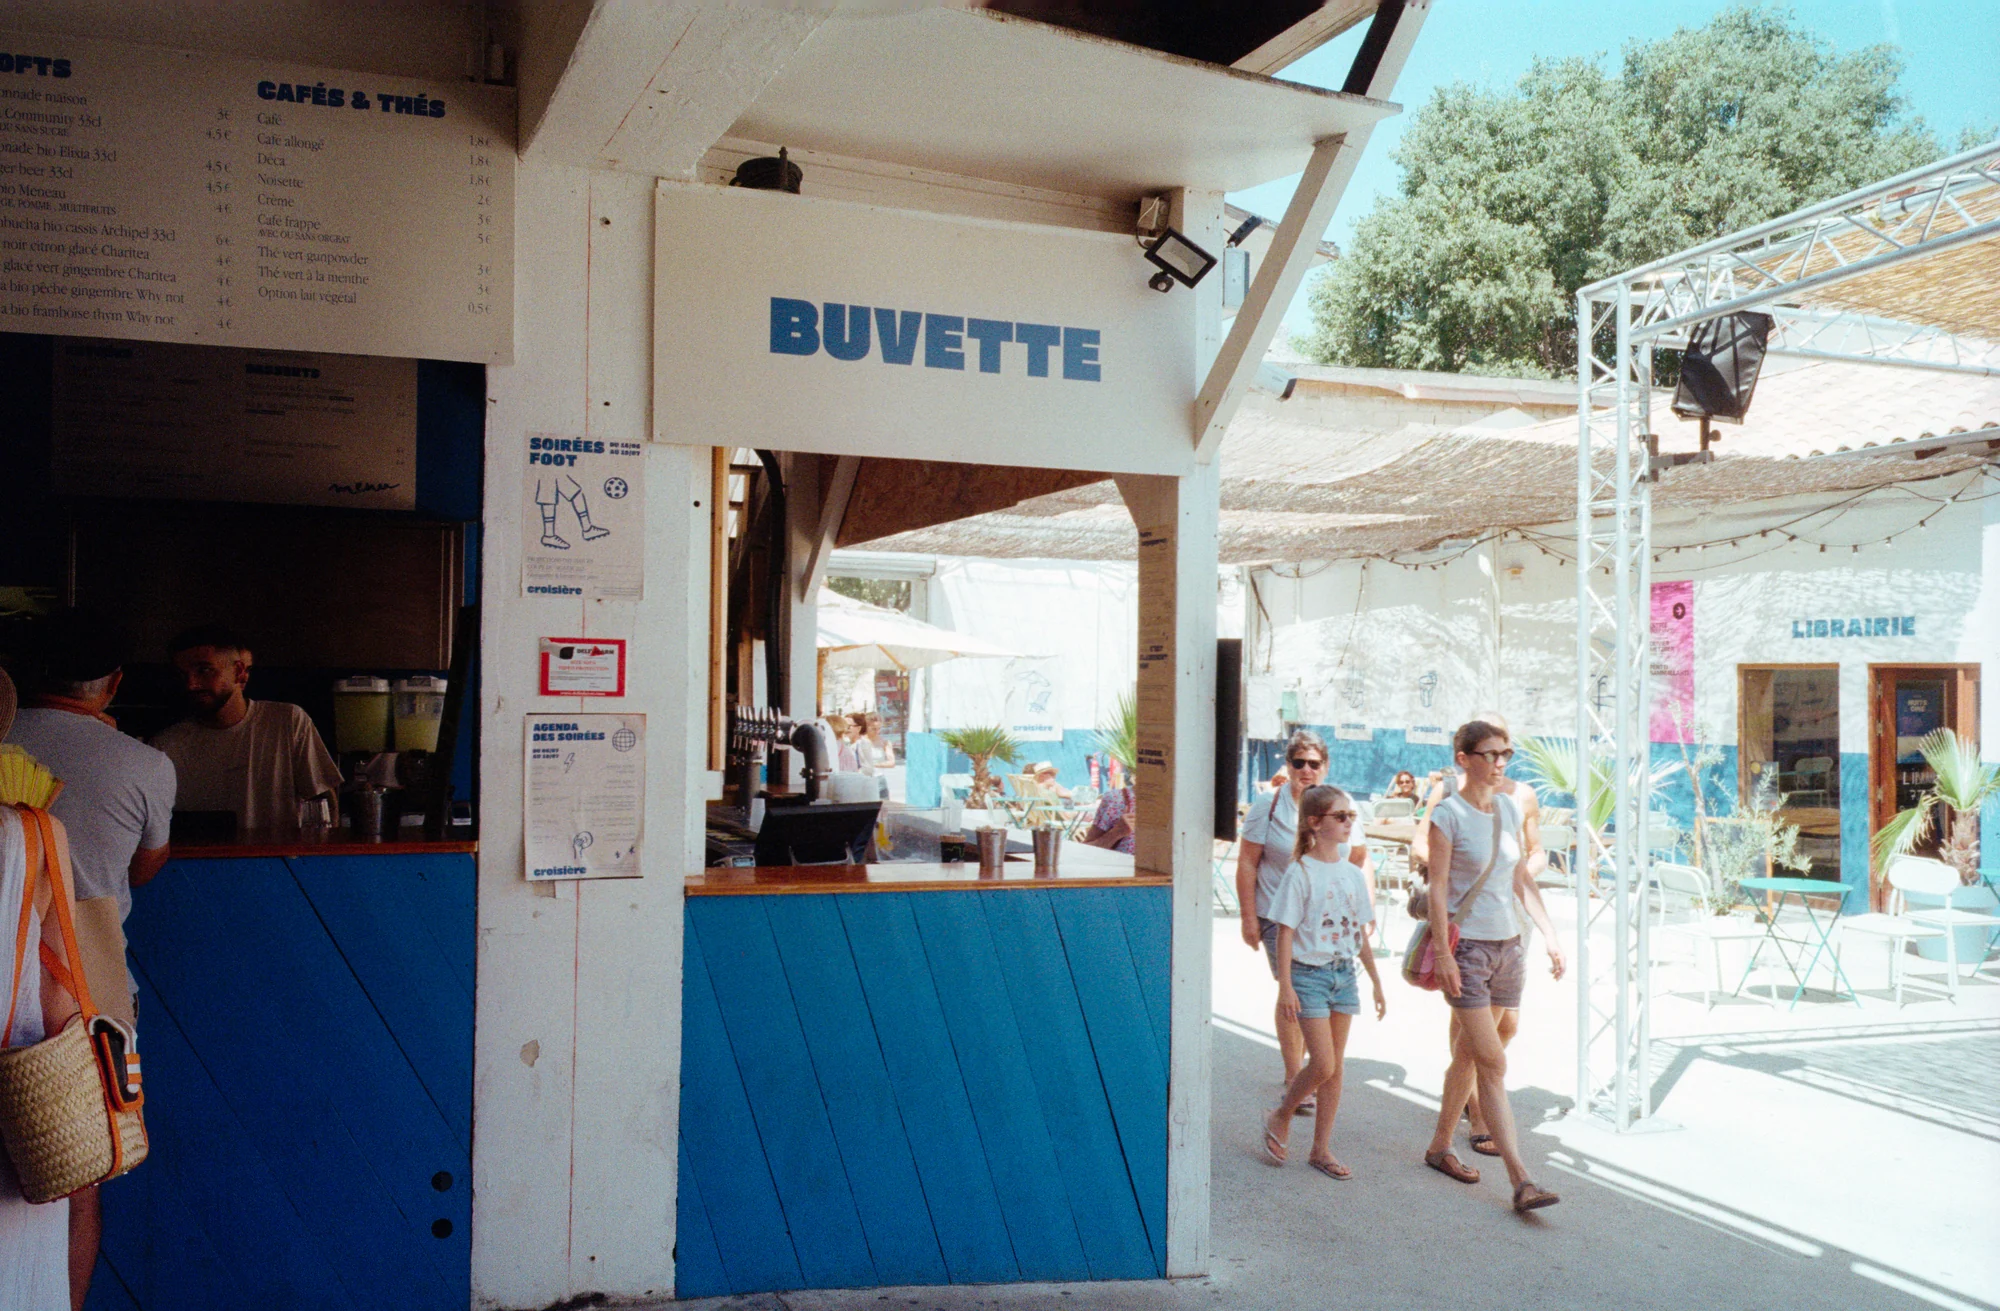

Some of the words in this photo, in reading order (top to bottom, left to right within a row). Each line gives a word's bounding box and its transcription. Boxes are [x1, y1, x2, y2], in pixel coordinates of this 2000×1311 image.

[0, 52, 72, 78] OFTS
[45, 92, 88, 106] maison
[257, 81, 345, 108] CAFÉS
[351, 91, 371, 110] &
[377, 93, 446, 118] THÉS
[5, 107, 75, 128] Community
[257, 112, 283, 126] Café
[36, 143, 56, 157] bio
[257, 133, 282, 147] Café
[284, 135, 325, 152] allongé
[257, 152, 286, 167] Déca
[19, 162, 46, 178] beer
[257, 173, 304, 189] Noisette
[19, 184, 66, 199] Meneau
[257, 193, 295, 208] Crème
[43, 218, 63, 233] bio
[65, 223, 98, 236] cassis
[101, 223, 149, 242] Archipel
[152, 228, 176, 242] 33cl
[257, 213, 283, 228] Café
[285, 216, 321, 232] frappé
[3, 239, 28, 251] noir
[30, 241, 65, 254] citron
[68, 243, 98, 257] glacé
[101, 244, 150, 261] Charitea
[257, 245, 280, 259] Thé
[283, 249, 304, 262] vert
[306, 252, 369, 267] gunpowder
[3, 258, 34, 274] glacé
[36, 262, 59, 274] vert
[62, 263, 126, 279] gingembre
[128, 267, 177, 284] Charitea
[257, 265, 280, 279] Thé
[283, 269, 304, 281] vert
[306, 268, 314, 281] à
[316, 269, 326, 283] la
[328, 272, 369, 286] menthe
[9, 278, 29, 293] bio
[32, 281, 69, 297] pêche
[71, 285, 134, 301] gingembre
[136, 288, 162, 304] Why
[165, 291, 185, 304] not
[257, 285, 298, 302] Option
[300, 288, 317, 302] lait
[319, 291, 358, 307] végétal
[9, 302, 30, 317] bio
[33, 302, 91, 319] framboise
[93, 306, 123, 323] thym
[126, 309, 152, 329] Why
[155, 314, 175, 326] not
[769, 296, 1102, 382] BUVETTE
[530, 436, 605, 454] SOIRÉES
[529, 452, 577, 467] FOOT
[527, 584, 583, 595] croisière
[1792, 616, 1917, 639] LIBRAIRIE
[533, 723, 579, 732] AGENDA
[533, 732, 556, 742] DES
[557, 729, 606, 742] SOIRÉES
[1013, 723, 1053, 732] croisière
[533, 865, 587, 877] croisière
